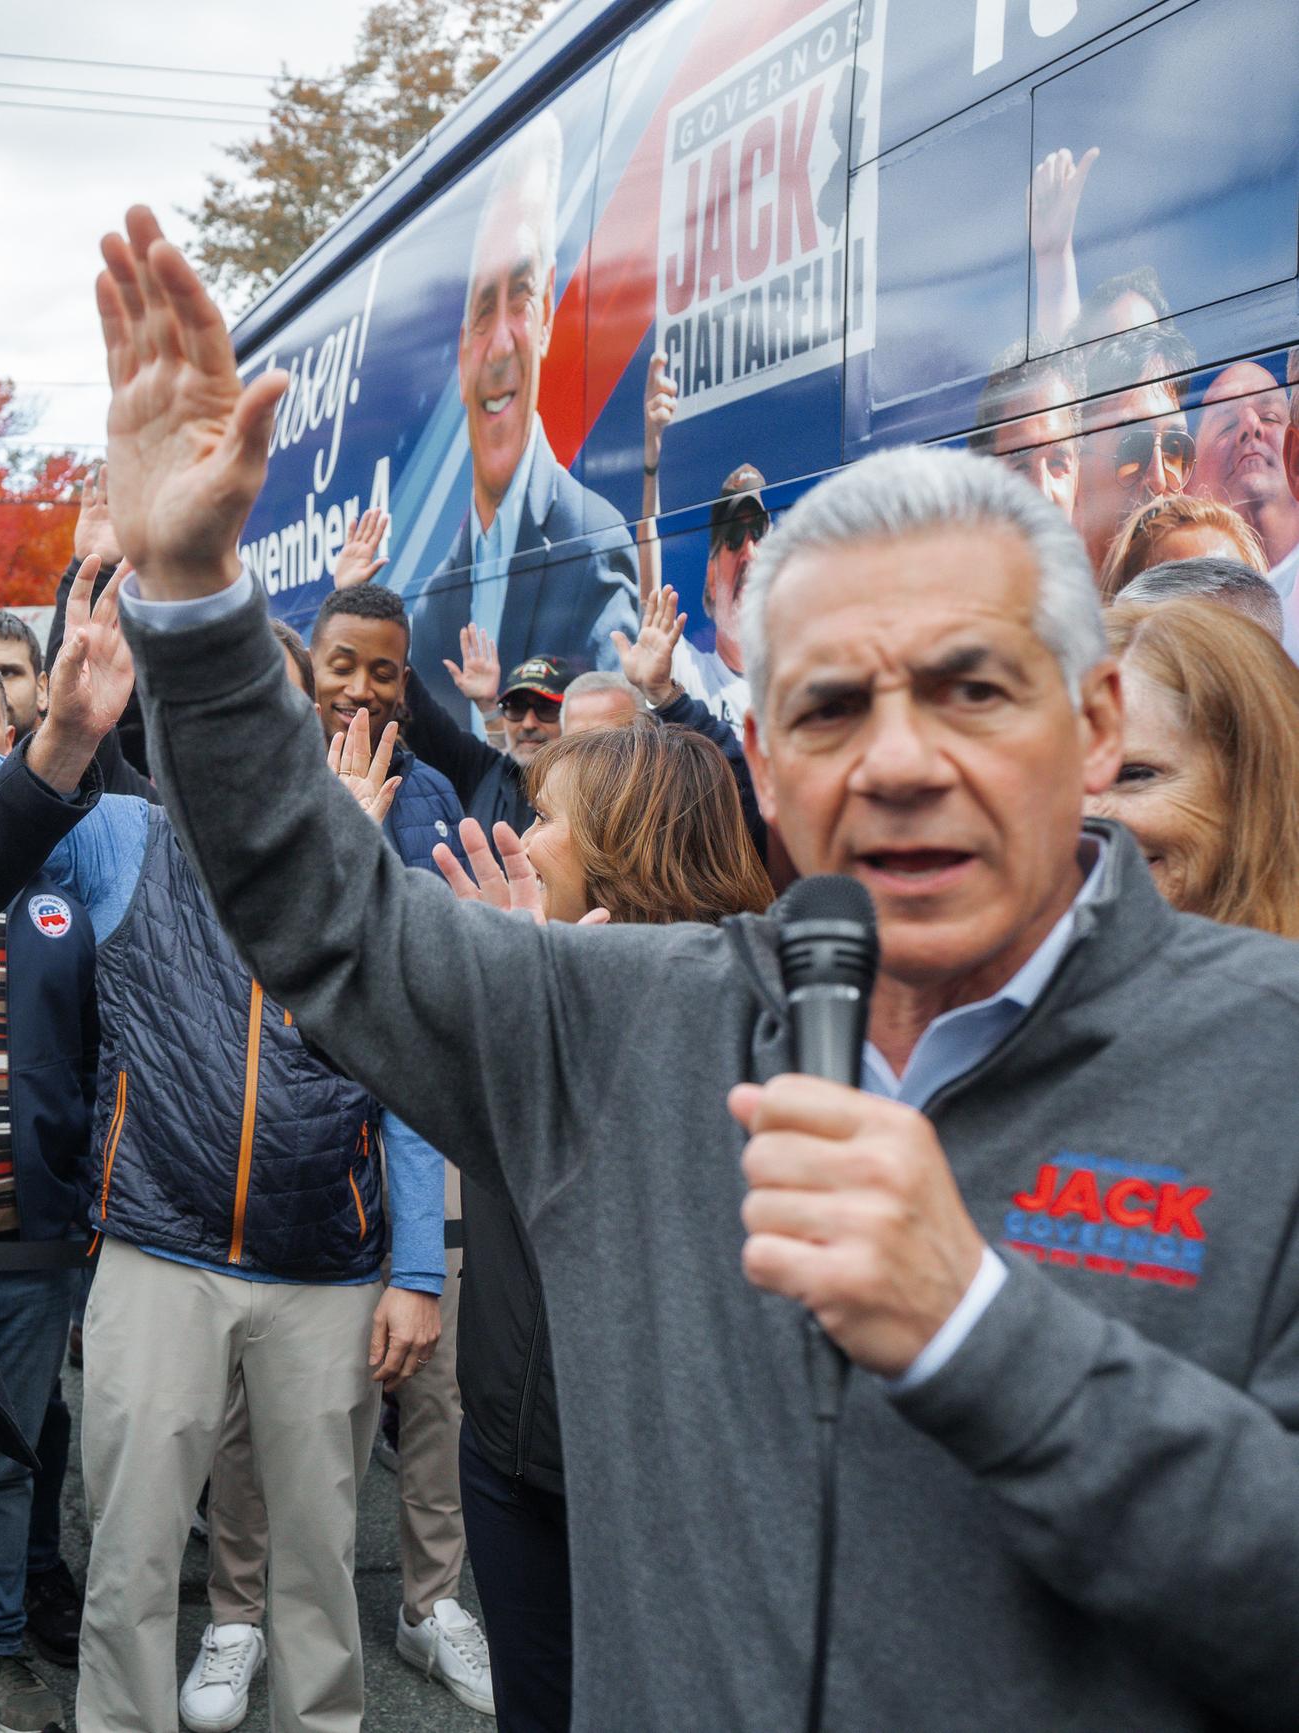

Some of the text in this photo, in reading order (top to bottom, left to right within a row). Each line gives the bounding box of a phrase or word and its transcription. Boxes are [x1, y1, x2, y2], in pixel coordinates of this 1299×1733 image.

[679, 6, 866, 149] GOVERNOR
[665, 82, 825, 316] JACK
[664, 237, 865, 398] CIATTARELLI
[369, 455, 393, 560] 4
[1012, 1163, 1213, 1241] JACK
